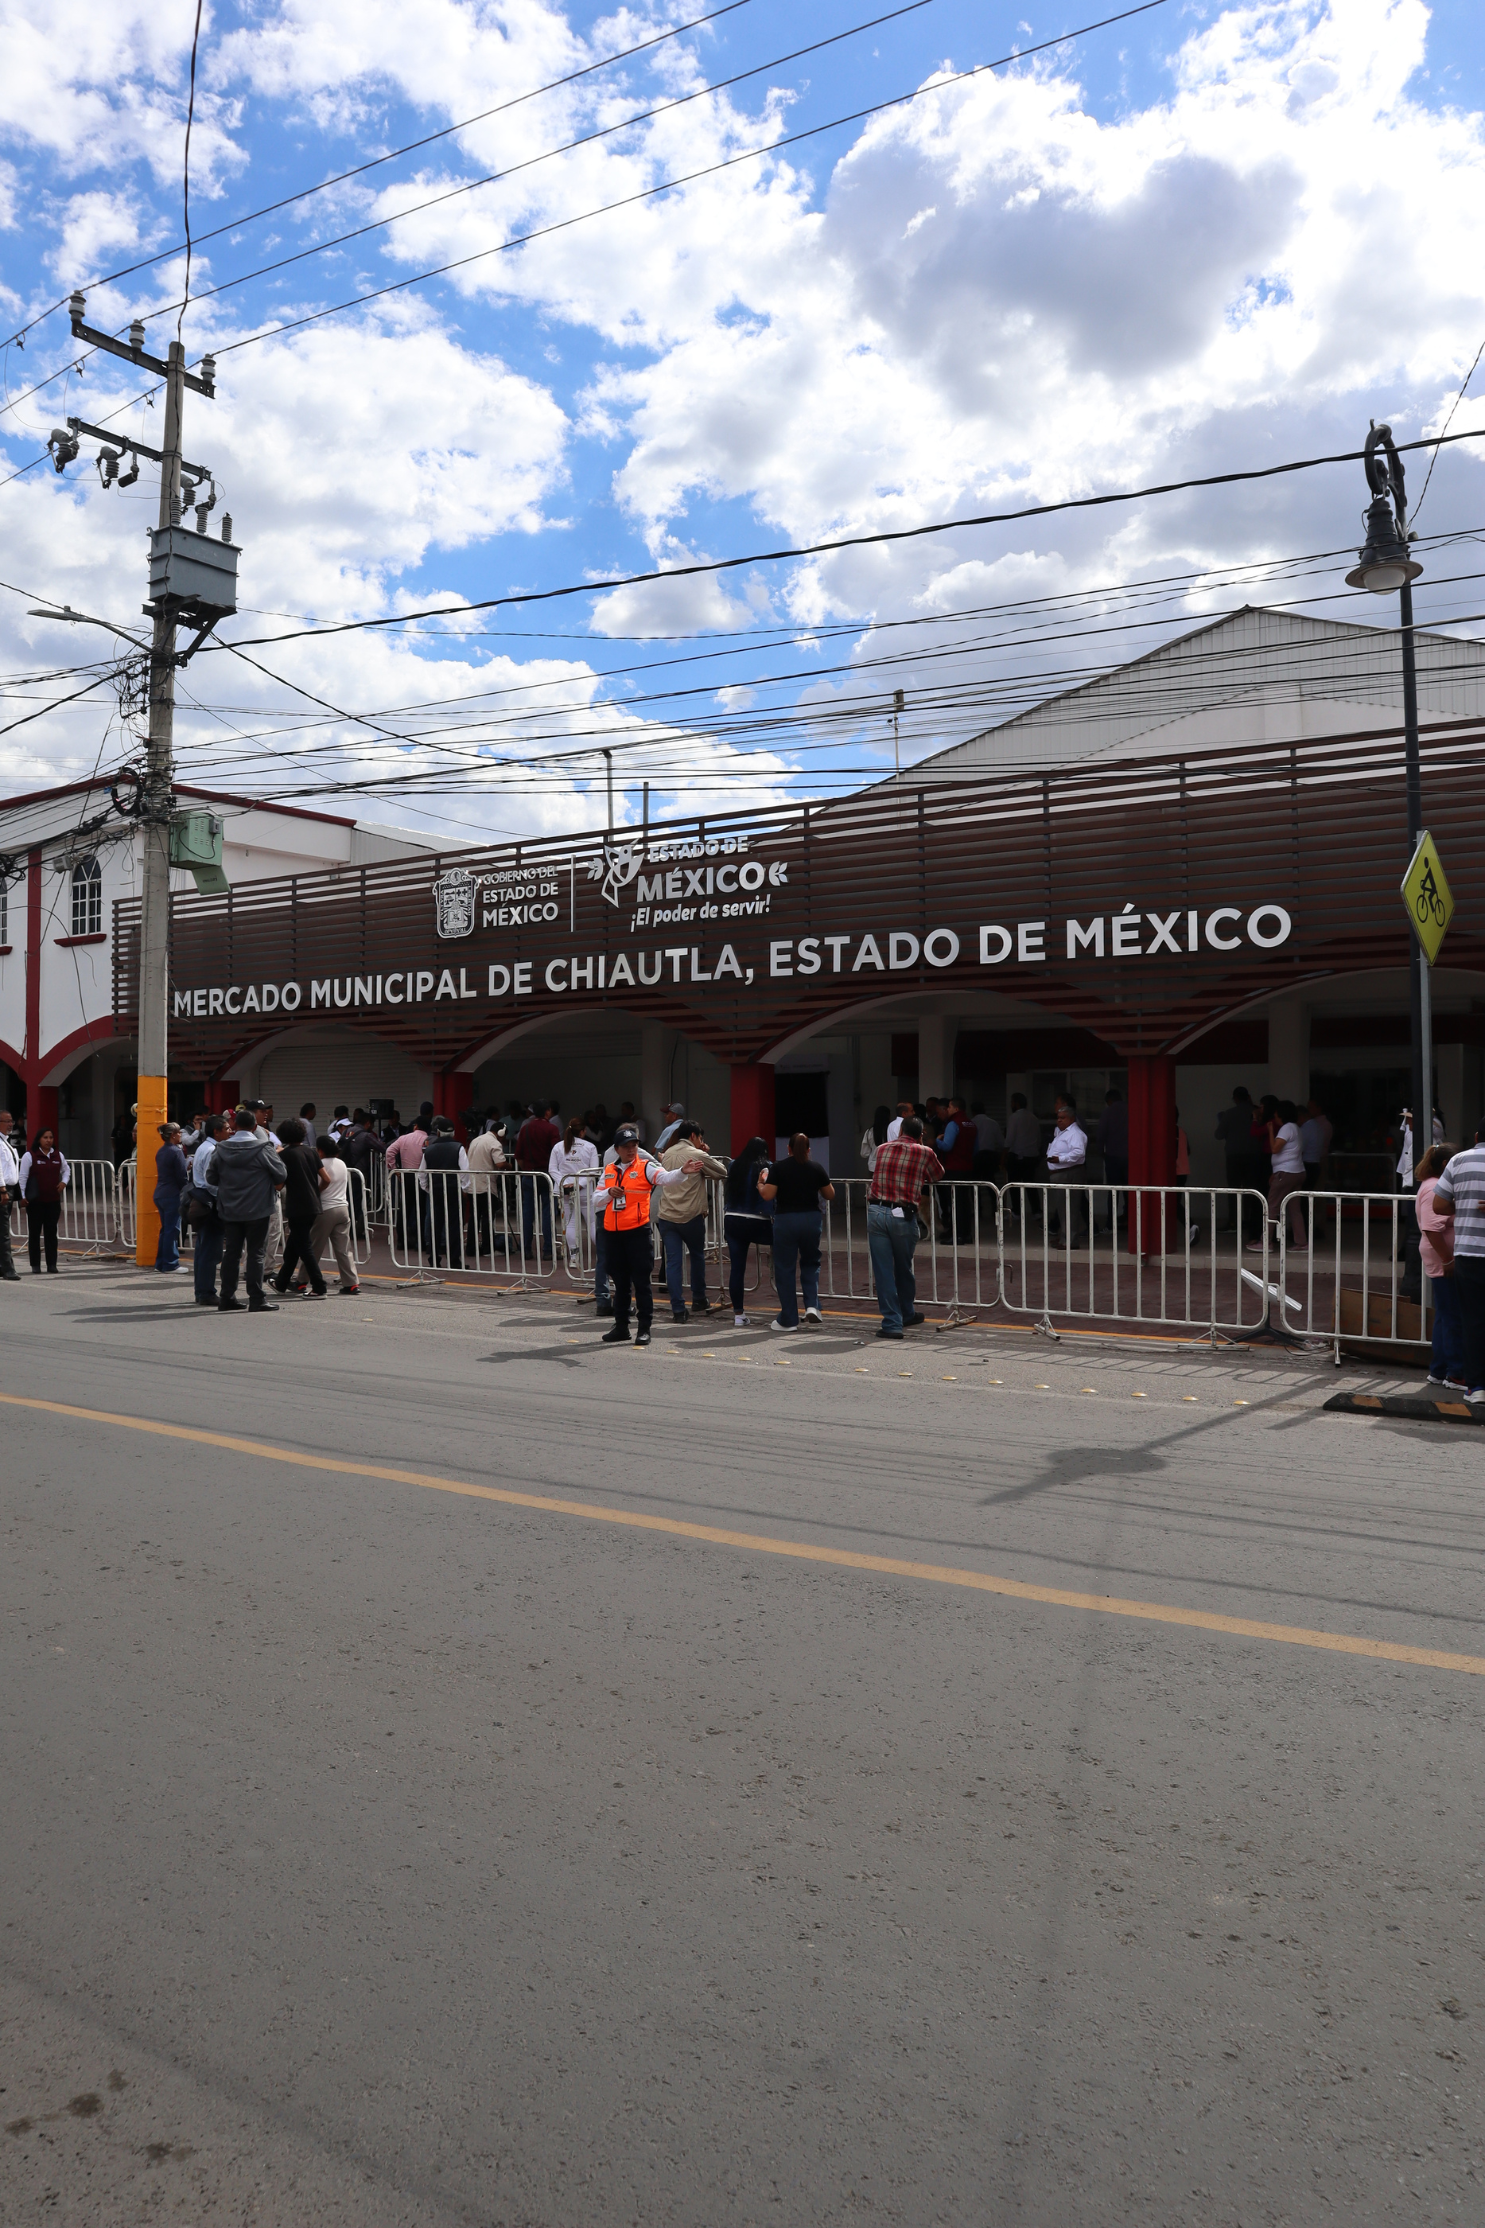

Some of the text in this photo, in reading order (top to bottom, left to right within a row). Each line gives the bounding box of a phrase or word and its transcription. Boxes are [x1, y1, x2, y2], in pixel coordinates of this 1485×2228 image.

[649, 836, 749, 863] ESTADO DE
[483, 867, 537, 885] GOBIERNO
[539, 865, 559, 879] DEL
[636, 861, 765, 903] MÉXICO
[482, 884, 537, 904] ESTADO
[540, 882, 559, 897] DE
[482, 901, 559, 928] MÉXICO
[630, 893, 772, 933] ¡El poder de servir!
[173, 902, 1292, 1018] MERCADO MUNICIPAL DE CHIAUTLA, ESTADO DE MÉXICO
